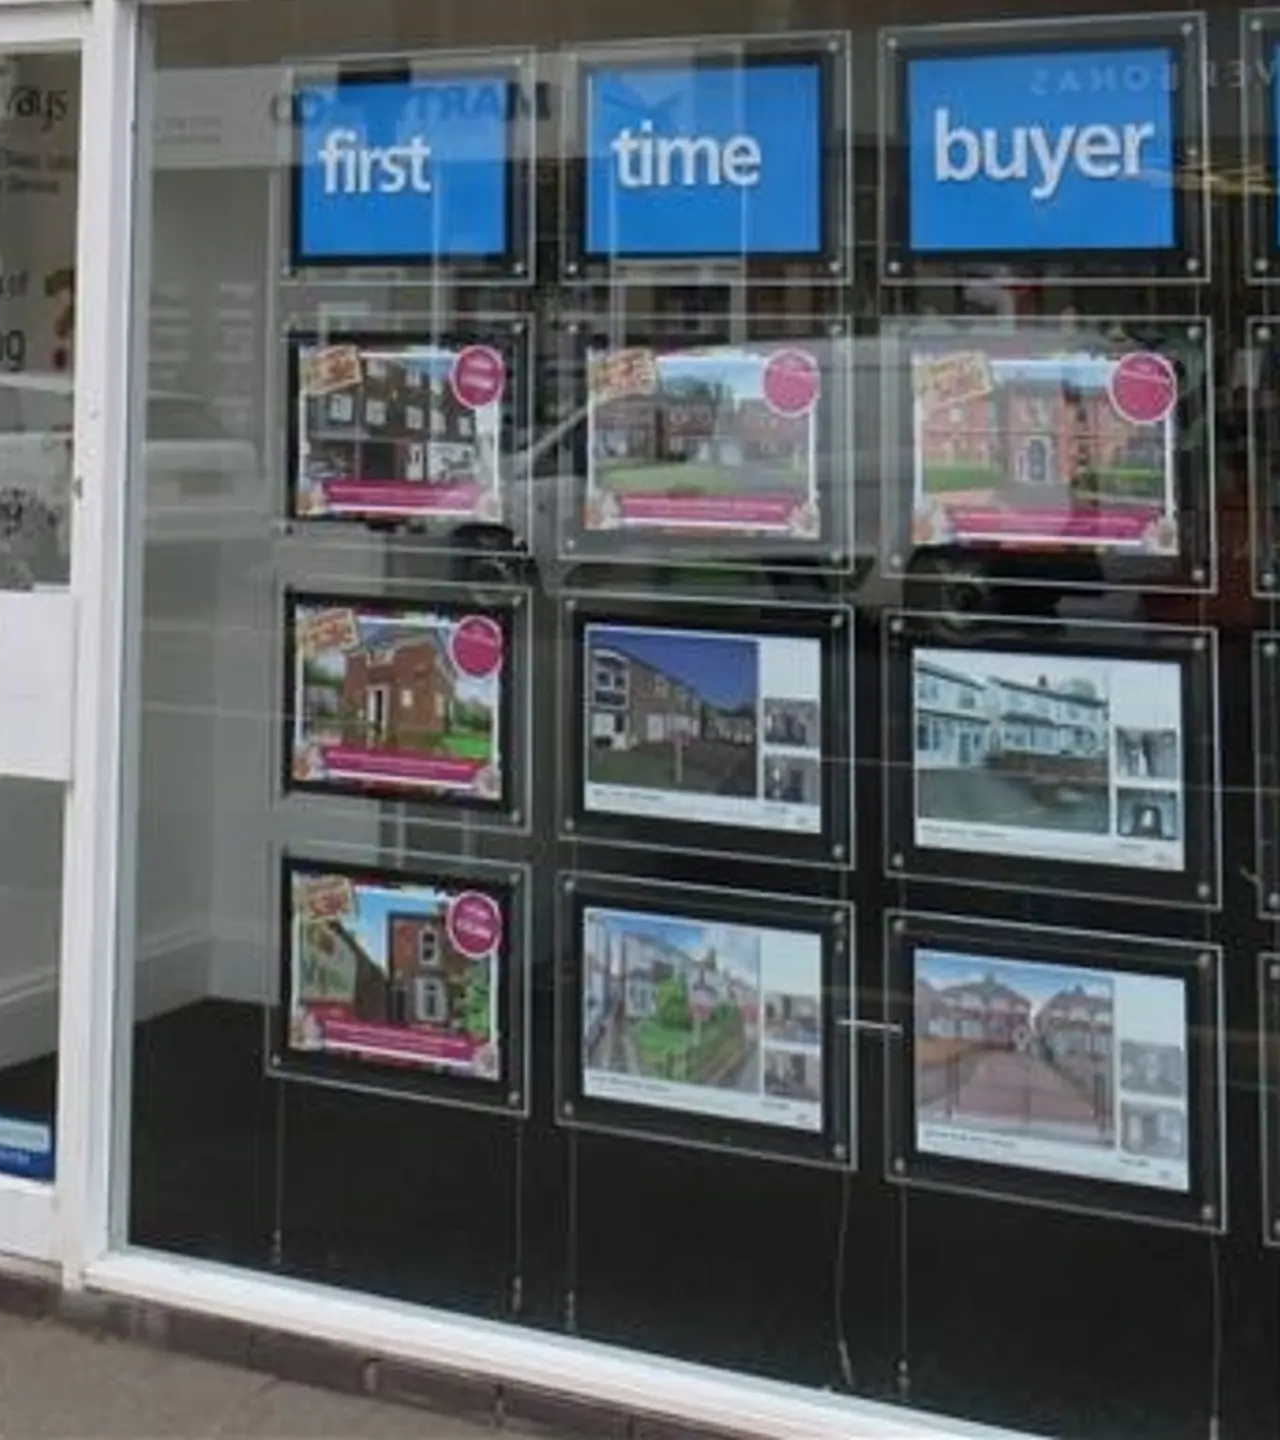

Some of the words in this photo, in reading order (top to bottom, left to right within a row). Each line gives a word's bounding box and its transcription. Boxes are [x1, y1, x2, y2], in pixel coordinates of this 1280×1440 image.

[319, 126, 433, 194] first
[611, 120, 763, 188] time
[933, 107, 1155, 200] buyer
